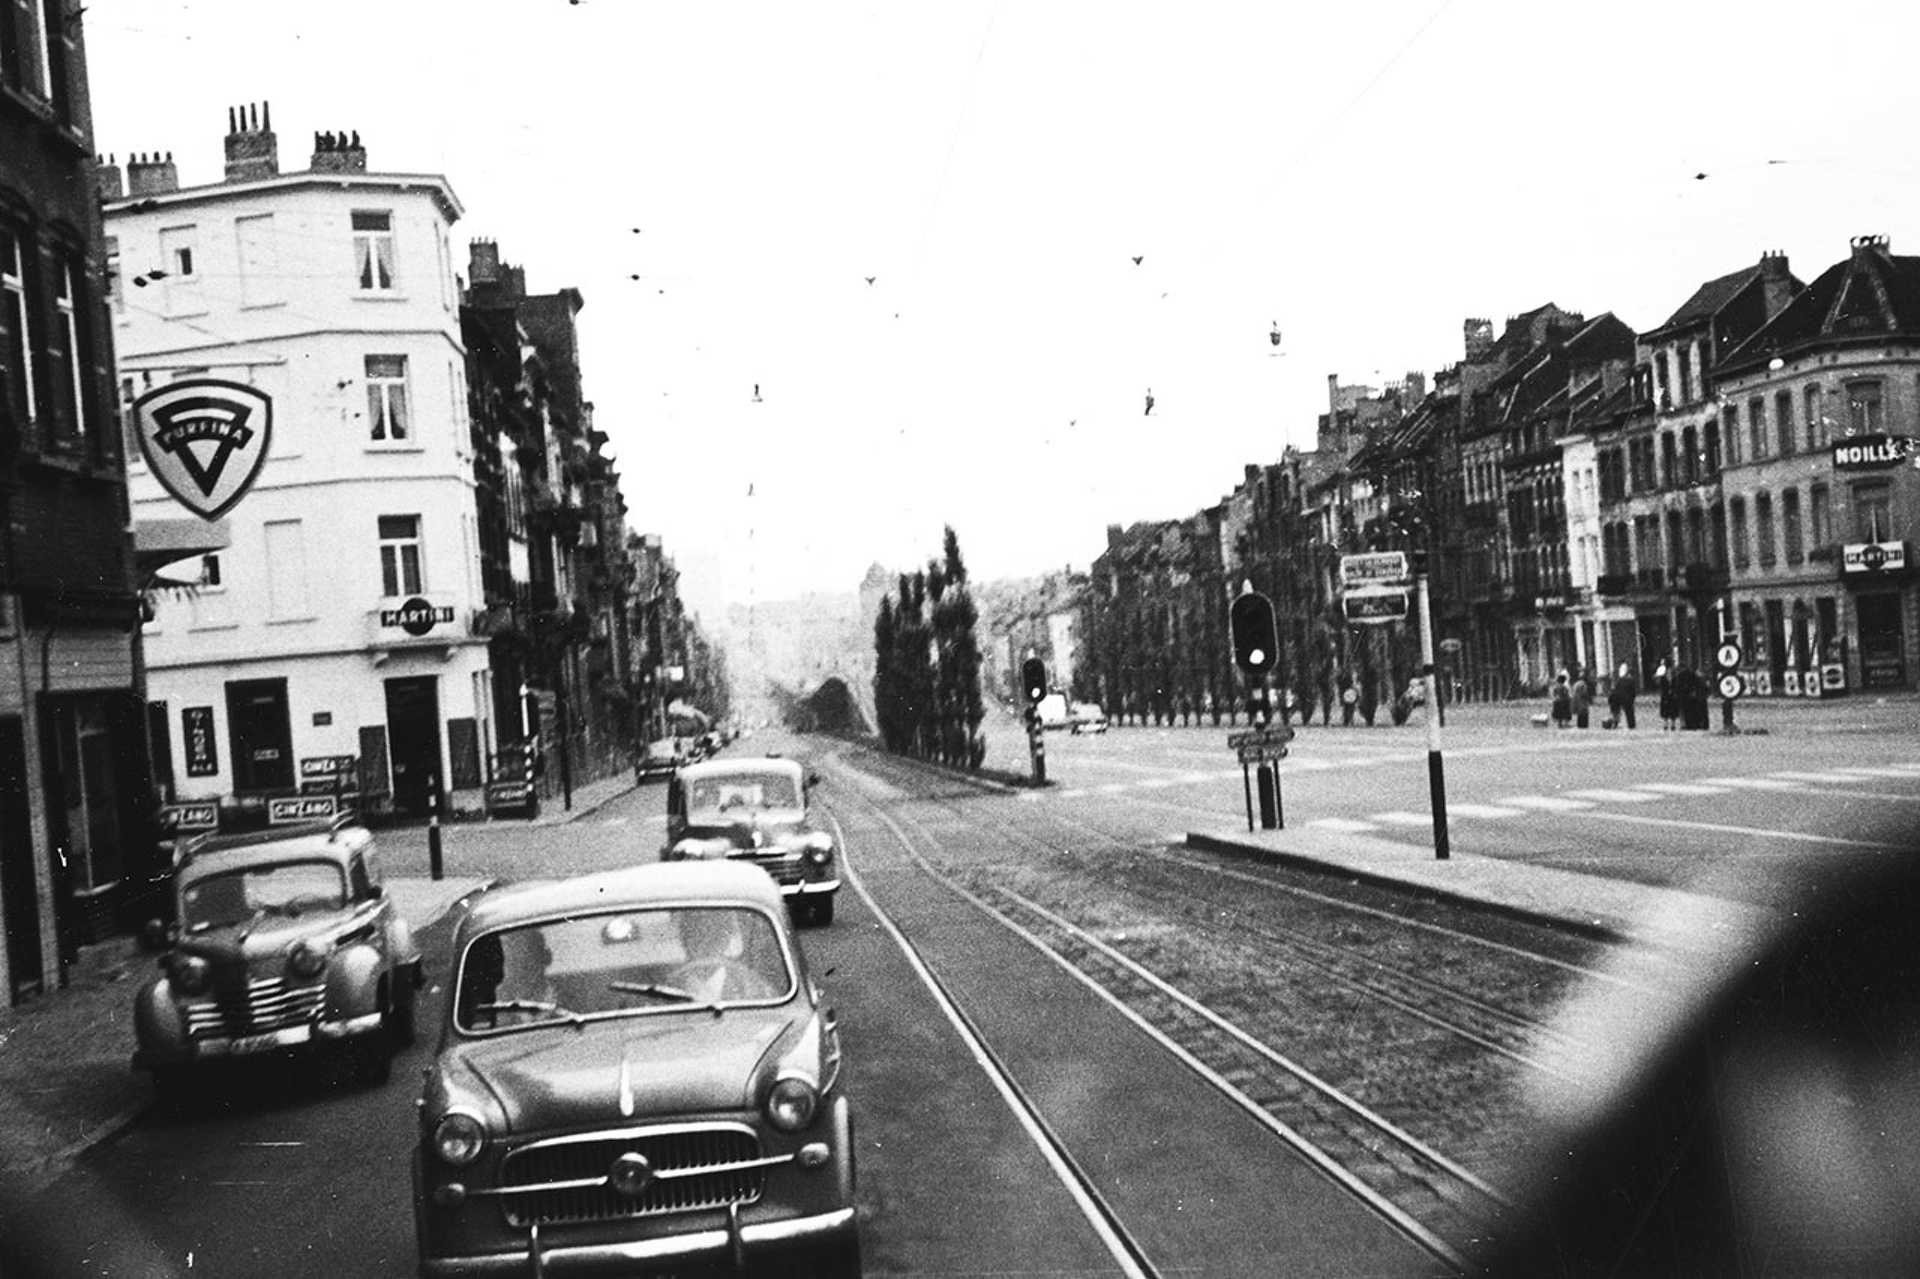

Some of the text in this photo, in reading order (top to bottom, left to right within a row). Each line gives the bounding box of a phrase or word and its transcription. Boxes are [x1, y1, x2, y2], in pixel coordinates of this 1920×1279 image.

[1846, 549, 1903, 563] MARTINI
[383, 607, 454, 628] MARTINI
[274, 801, 332, 817] CINZANO
